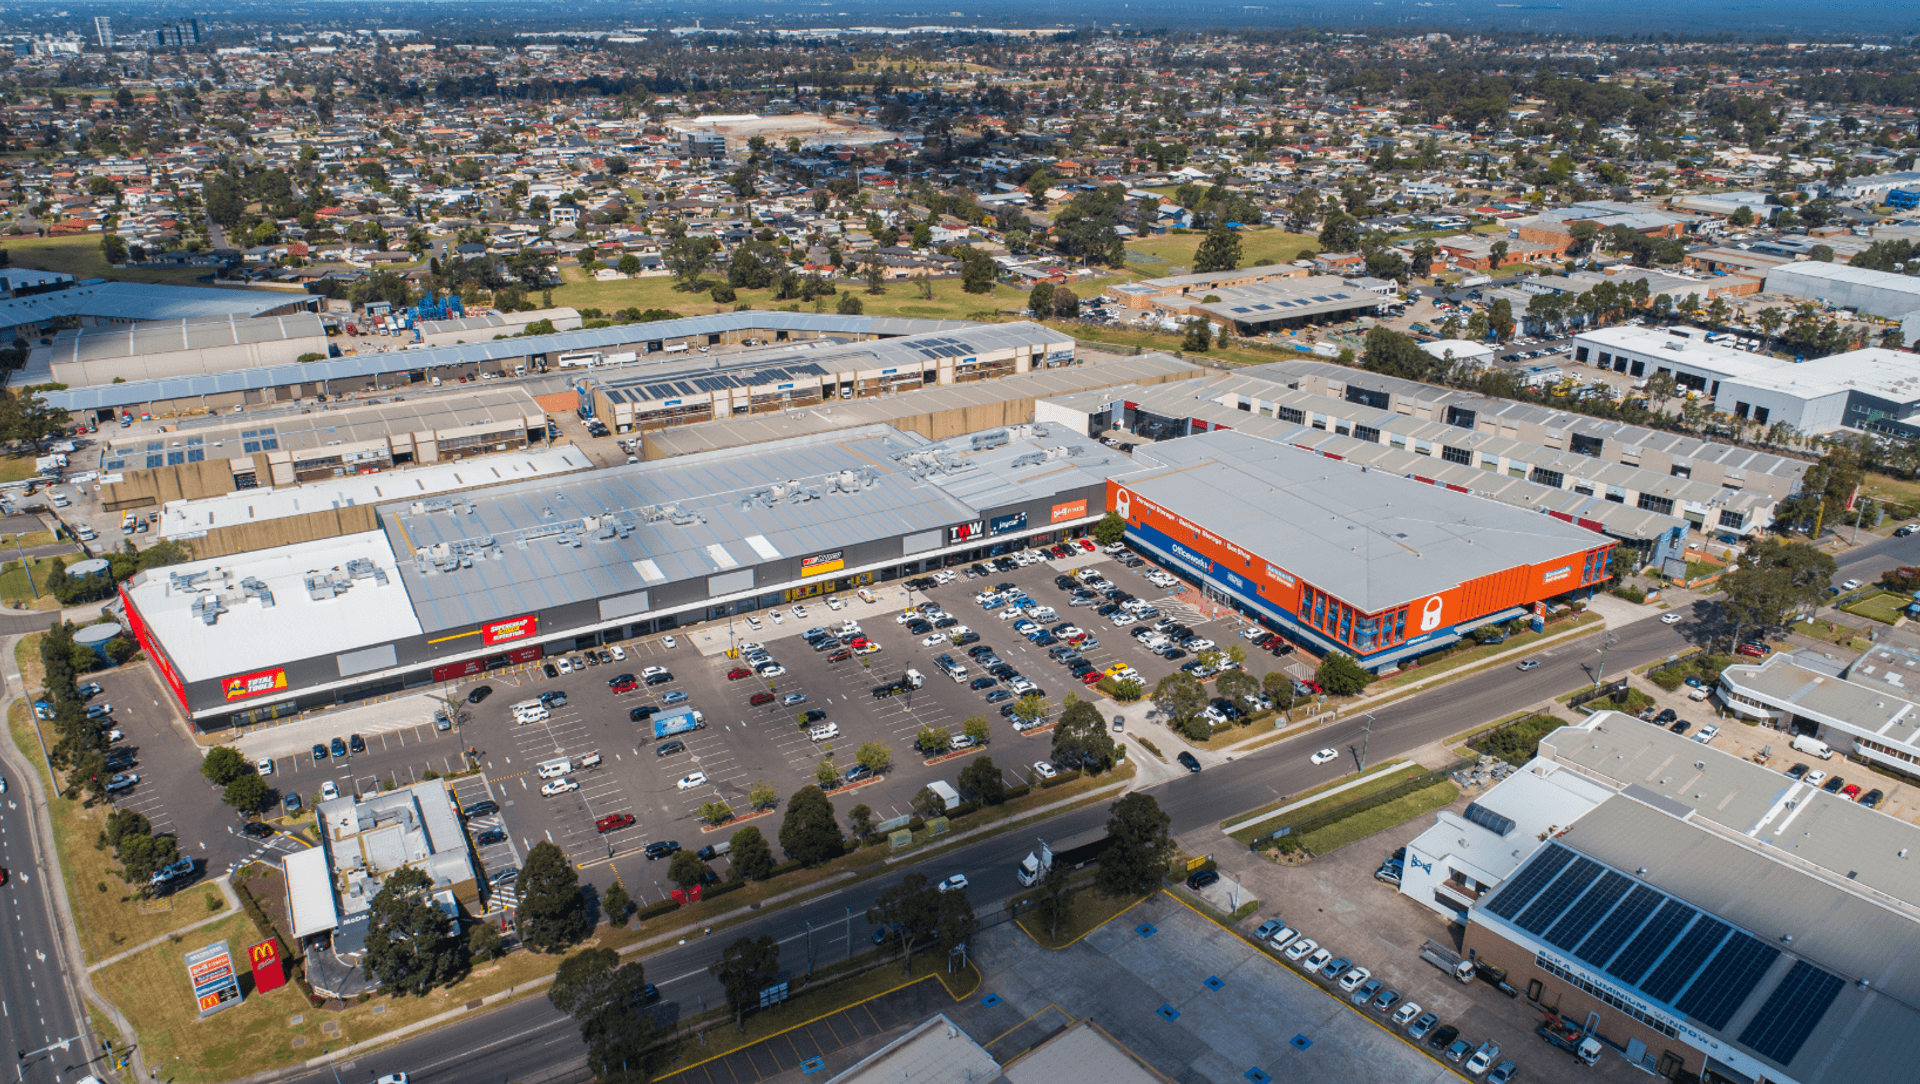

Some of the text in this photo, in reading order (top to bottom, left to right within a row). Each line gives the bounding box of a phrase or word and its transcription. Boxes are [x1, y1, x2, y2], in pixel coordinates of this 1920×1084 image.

[950, 521, 983, 539] TWW
[999, 519, 1019, 530] jaycar
[1137, 496, 1251, 560] Personal Storage Business Storage Box Shop
[1172, 544, 1208, 570] Officeworks
[247, 675, 273, 687] TOTAL
[248, 682, 274, 693] TOOLS
[1578, 972, 1647, 1011] ALUMINIUM
[1653, 1011, 1719, 1049] WINDOWS
